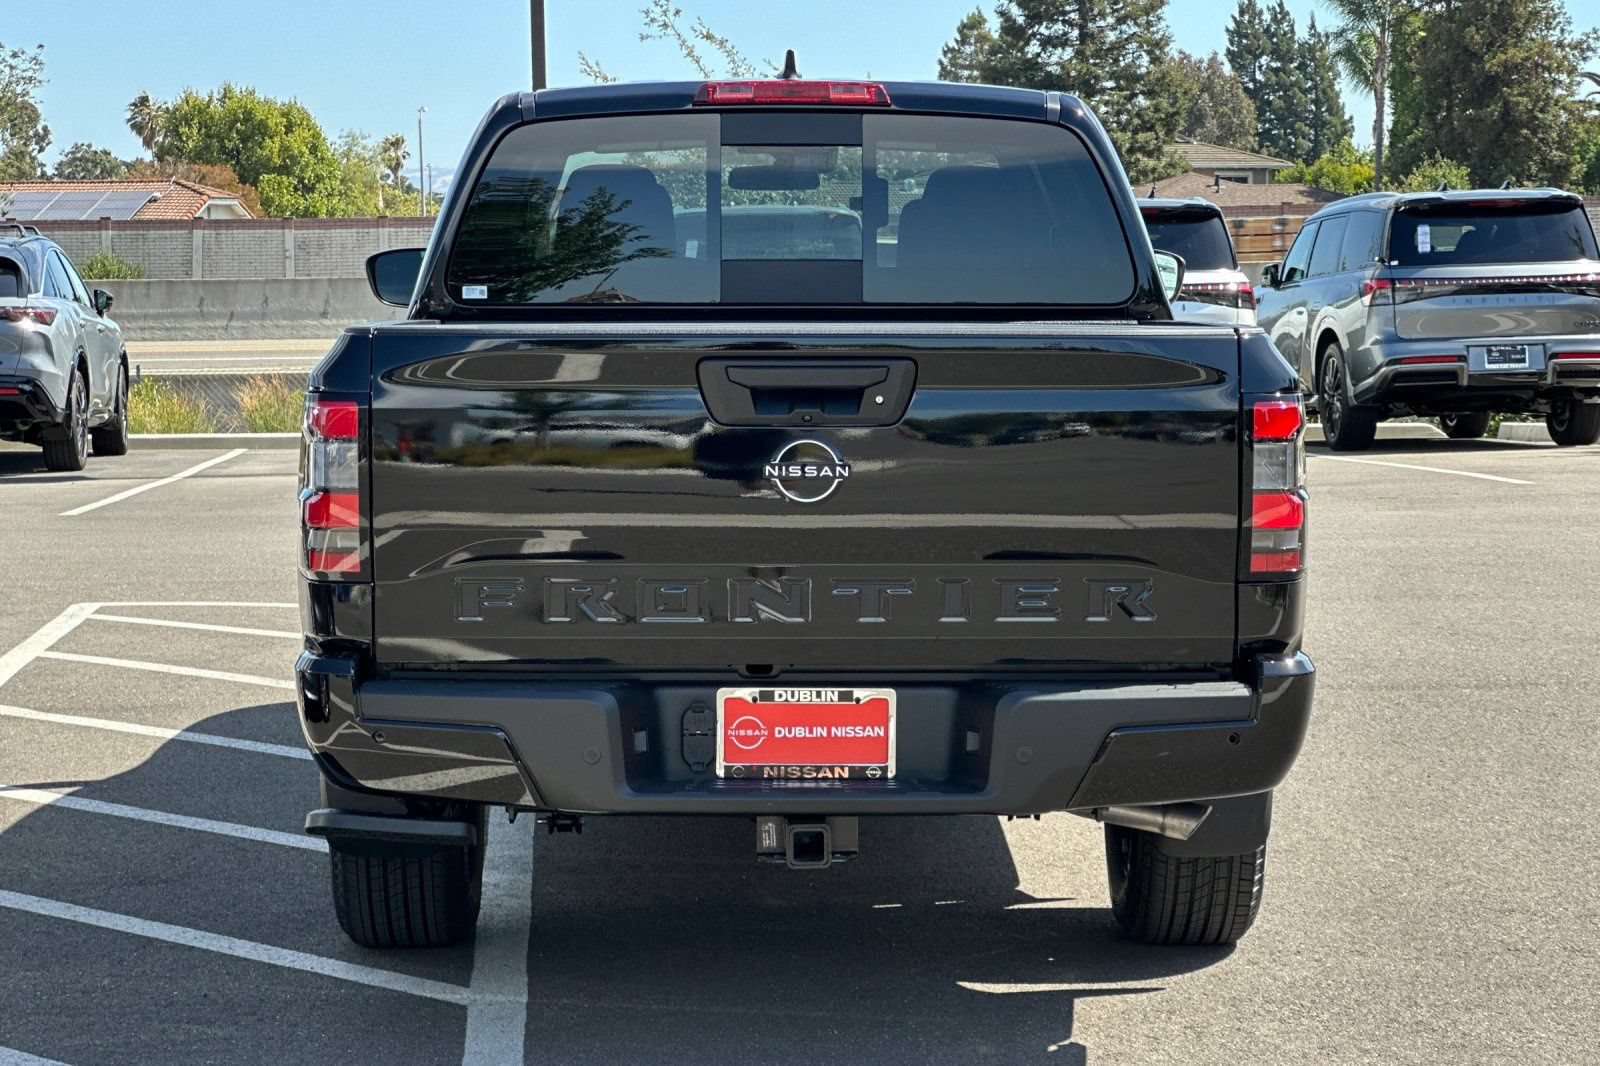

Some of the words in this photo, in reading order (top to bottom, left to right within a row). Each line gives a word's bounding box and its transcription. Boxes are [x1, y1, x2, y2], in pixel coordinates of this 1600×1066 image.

[765, 465, 849, 477] NISSAN
[454, 577, 1158, 623] FRONTIER
[774, 690, 839, 702] DUBLIN
[774, 727, 827, 738] DUBLIN
[831, 726, 884, 737] NISSAN
[763, 766, 849, 779] NISSAN
